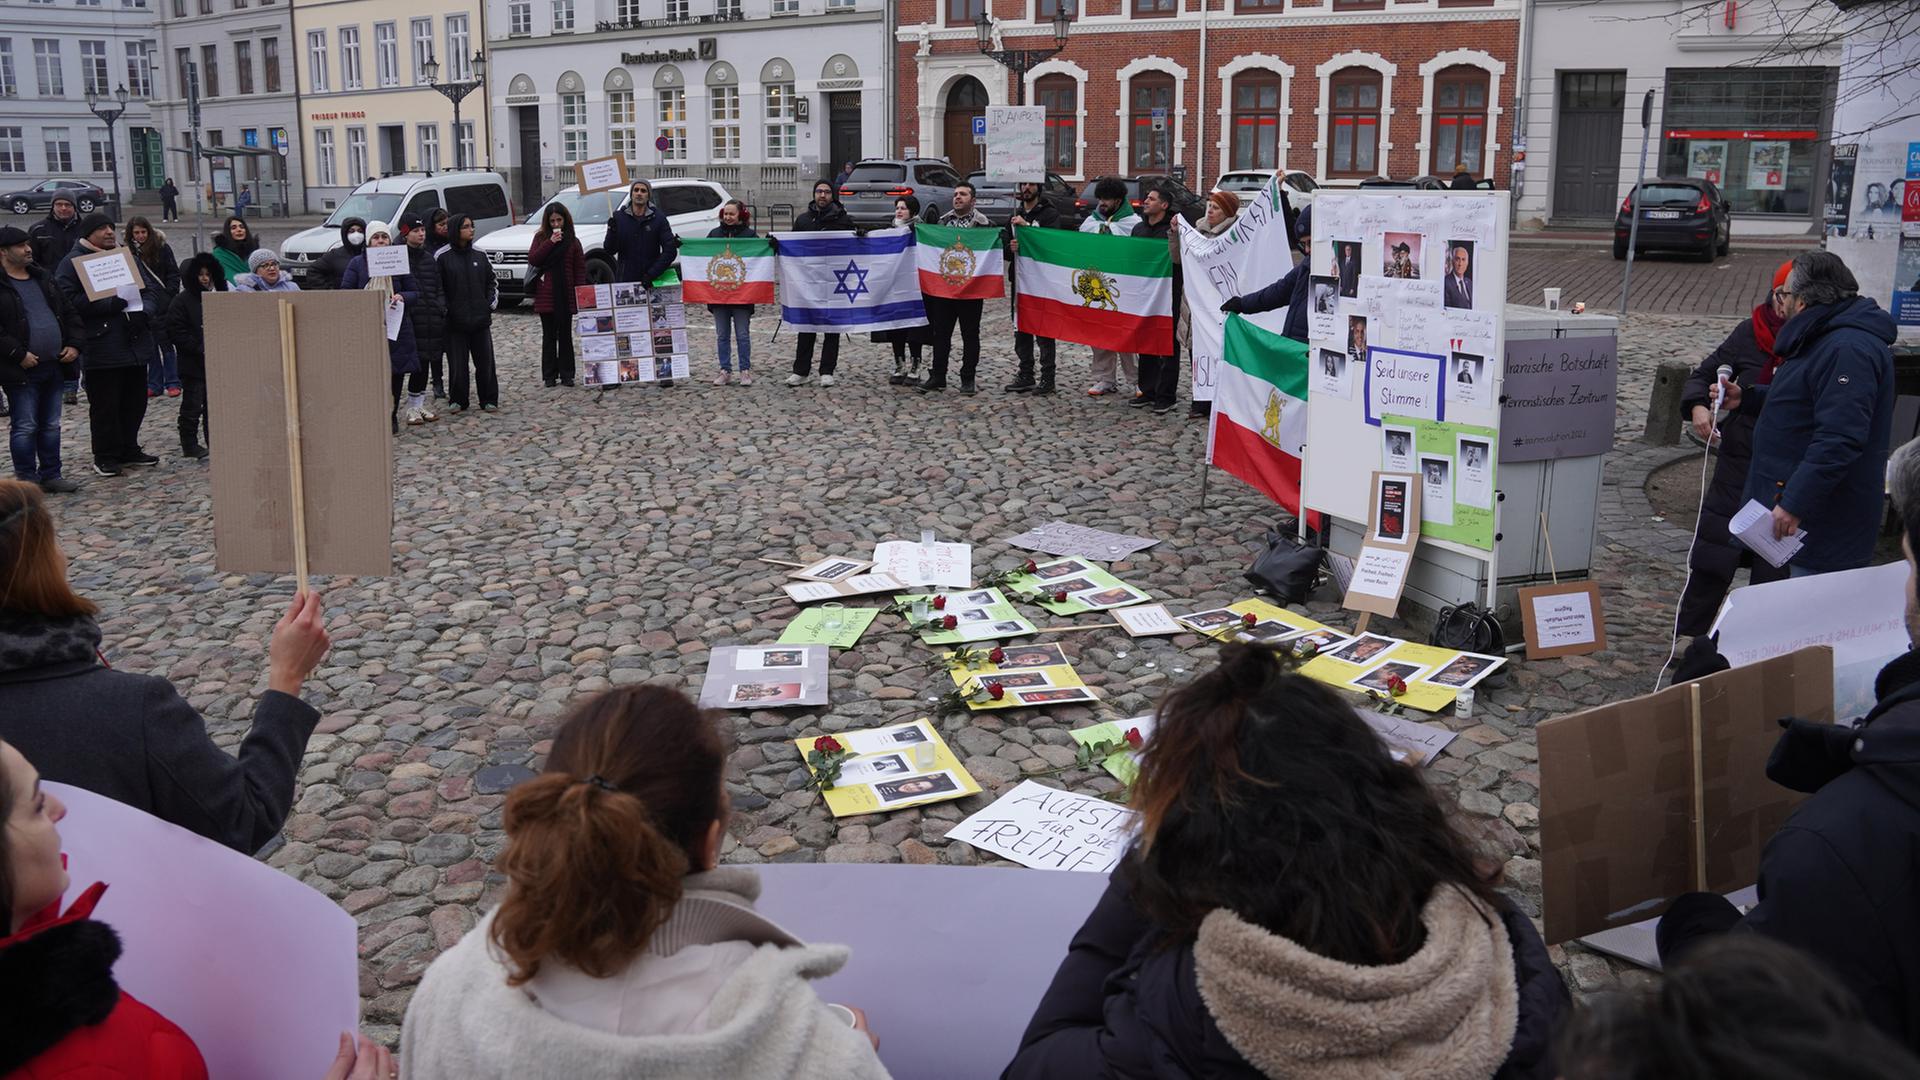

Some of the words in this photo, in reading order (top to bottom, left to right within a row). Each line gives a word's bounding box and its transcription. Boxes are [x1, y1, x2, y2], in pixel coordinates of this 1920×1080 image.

[621, 51, 669, 64] Deutsche
[669, 48, 698, 62] Bank
[311, 113, 338, 121] FRISEUR
[975, 119, 985, 133] P
[1375, 358, 1397, 379] Seid
[1397, 369, 1430, 383] unsere
[1560, 349, 1610, 376] Botschaft
[1380, 387, 1422, 408] Stimme
[1568, 384, 1609, 406] Zentrum
[1037, 820, 1074, 839] FÜR
